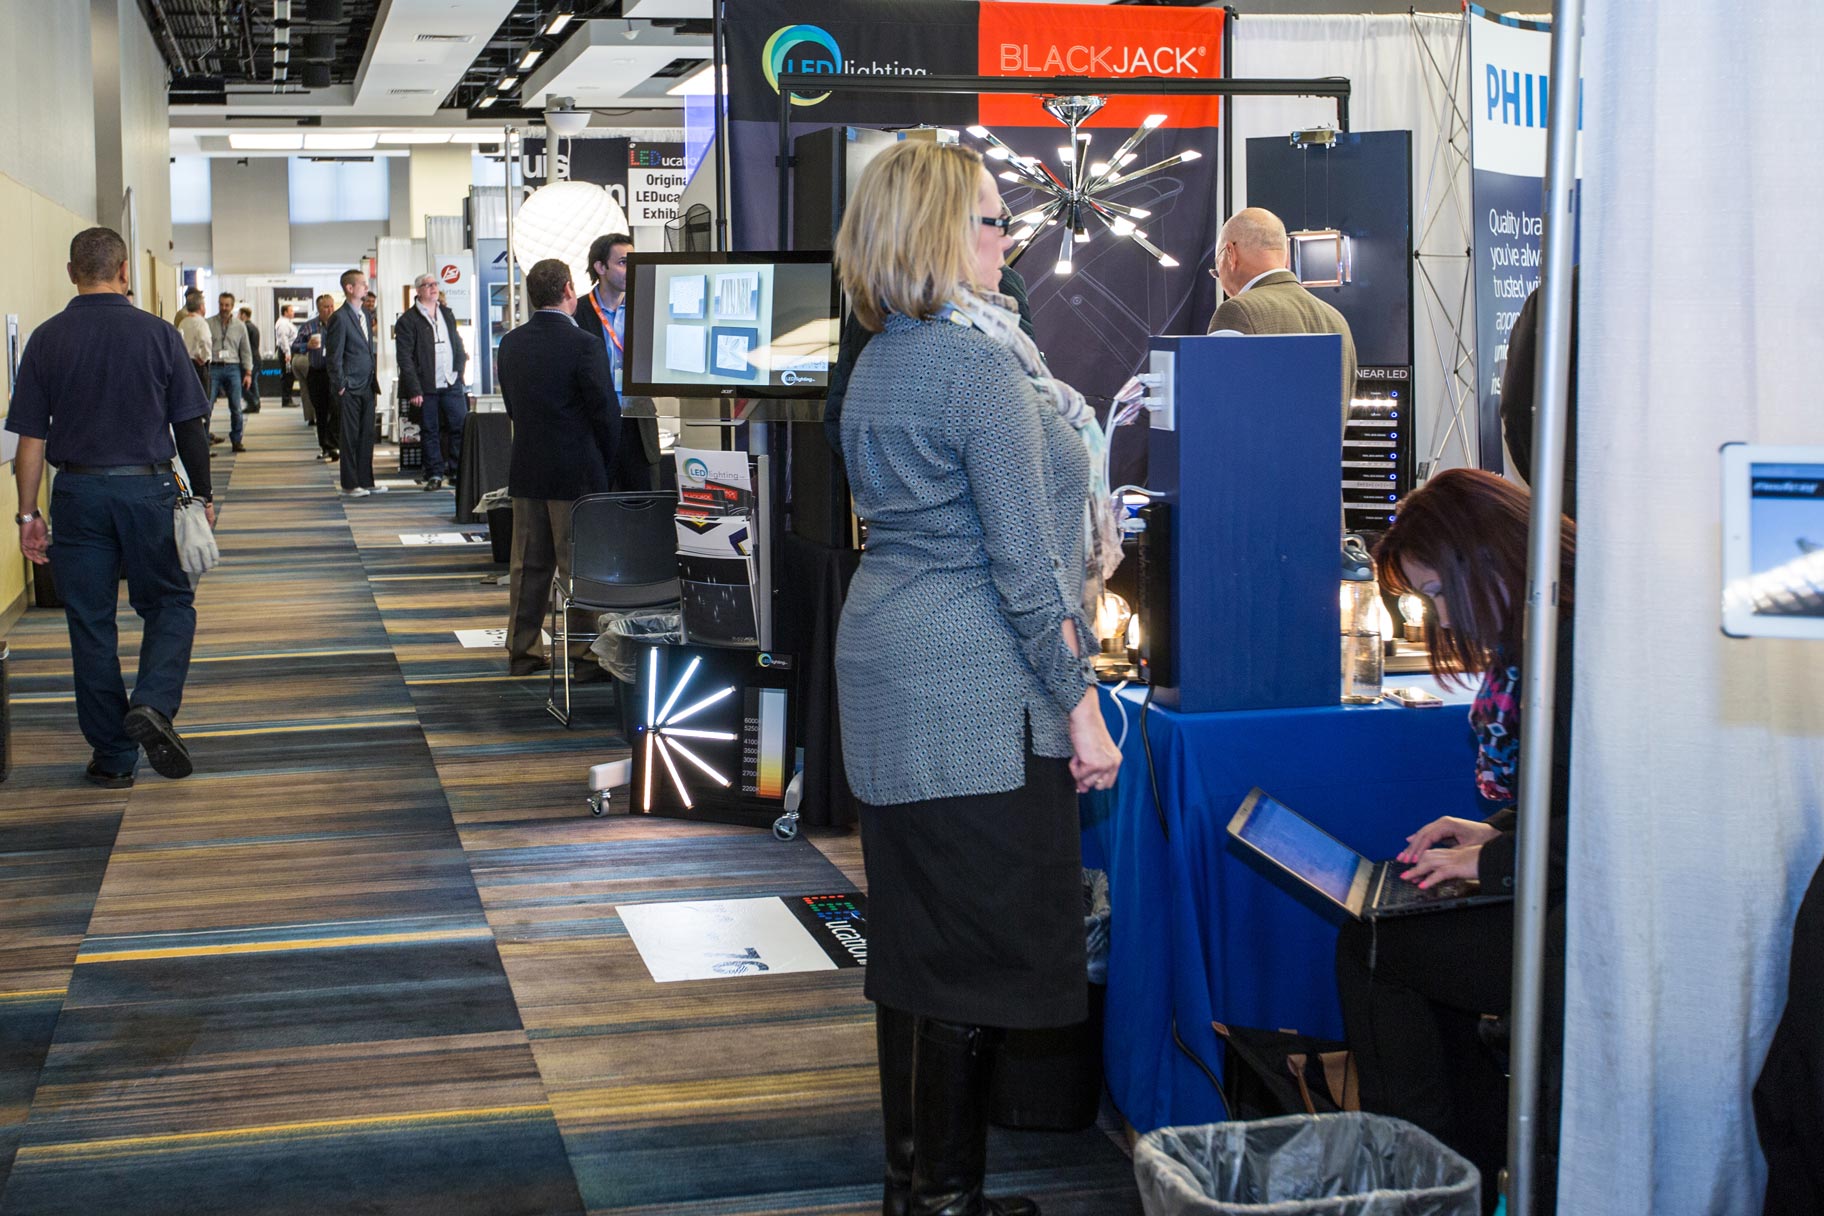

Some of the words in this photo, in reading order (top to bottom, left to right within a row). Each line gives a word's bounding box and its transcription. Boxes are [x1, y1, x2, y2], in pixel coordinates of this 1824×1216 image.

[1489, 208, 1520, 239] Quality
[1490, 243, 1520, 271] you've
[1387, 370, 1408, 379] LED
[690, 469, 706, 477] LED
